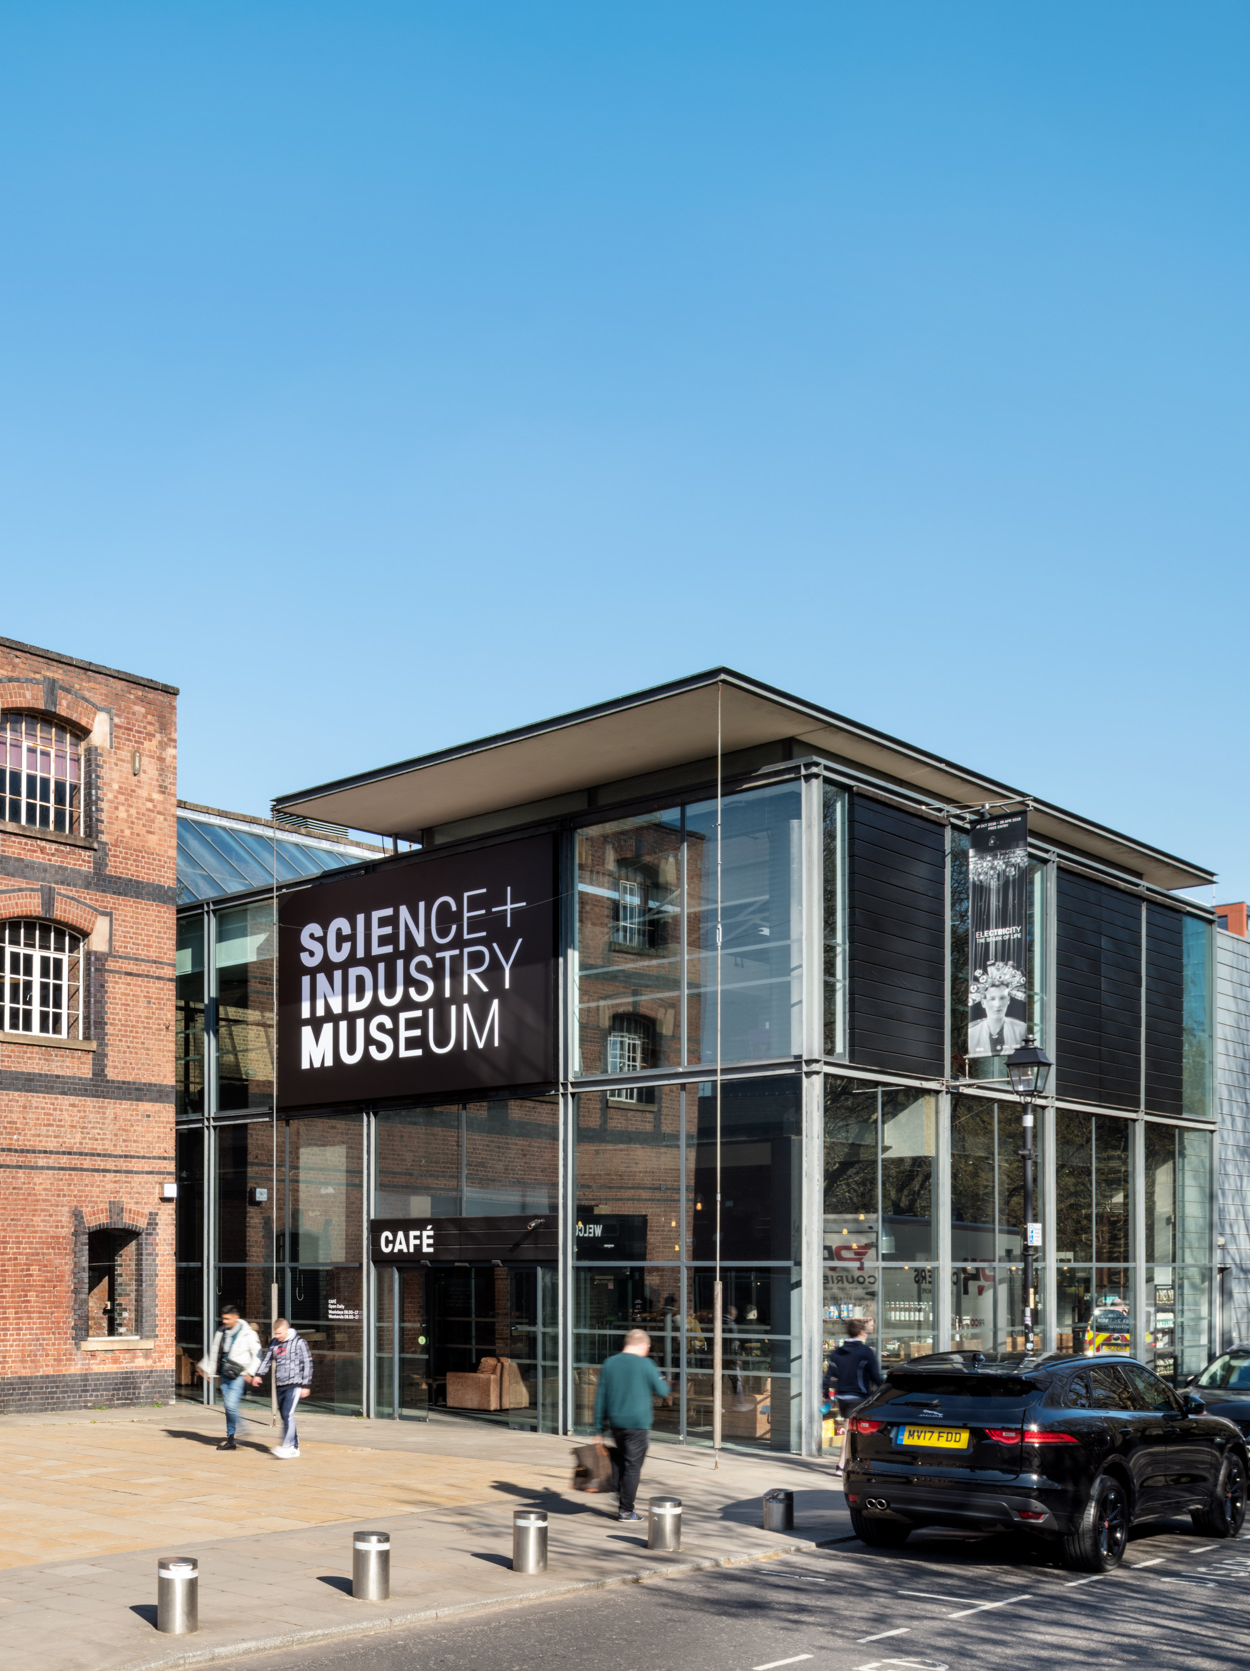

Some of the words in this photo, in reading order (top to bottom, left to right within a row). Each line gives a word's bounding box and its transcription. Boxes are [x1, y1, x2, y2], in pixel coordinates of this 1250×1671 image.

[976, 926, 1021, 938] ELECTRICITY
[301, 937, 523, 1020] INDUSTRY
[301, 998, 499, 1070] MUSEUM
[380, 1224, 434, 1253] CAFÉ
[907, 1429, 935, 1441] MV17
[937, 1431, 962, 1443] FDD
